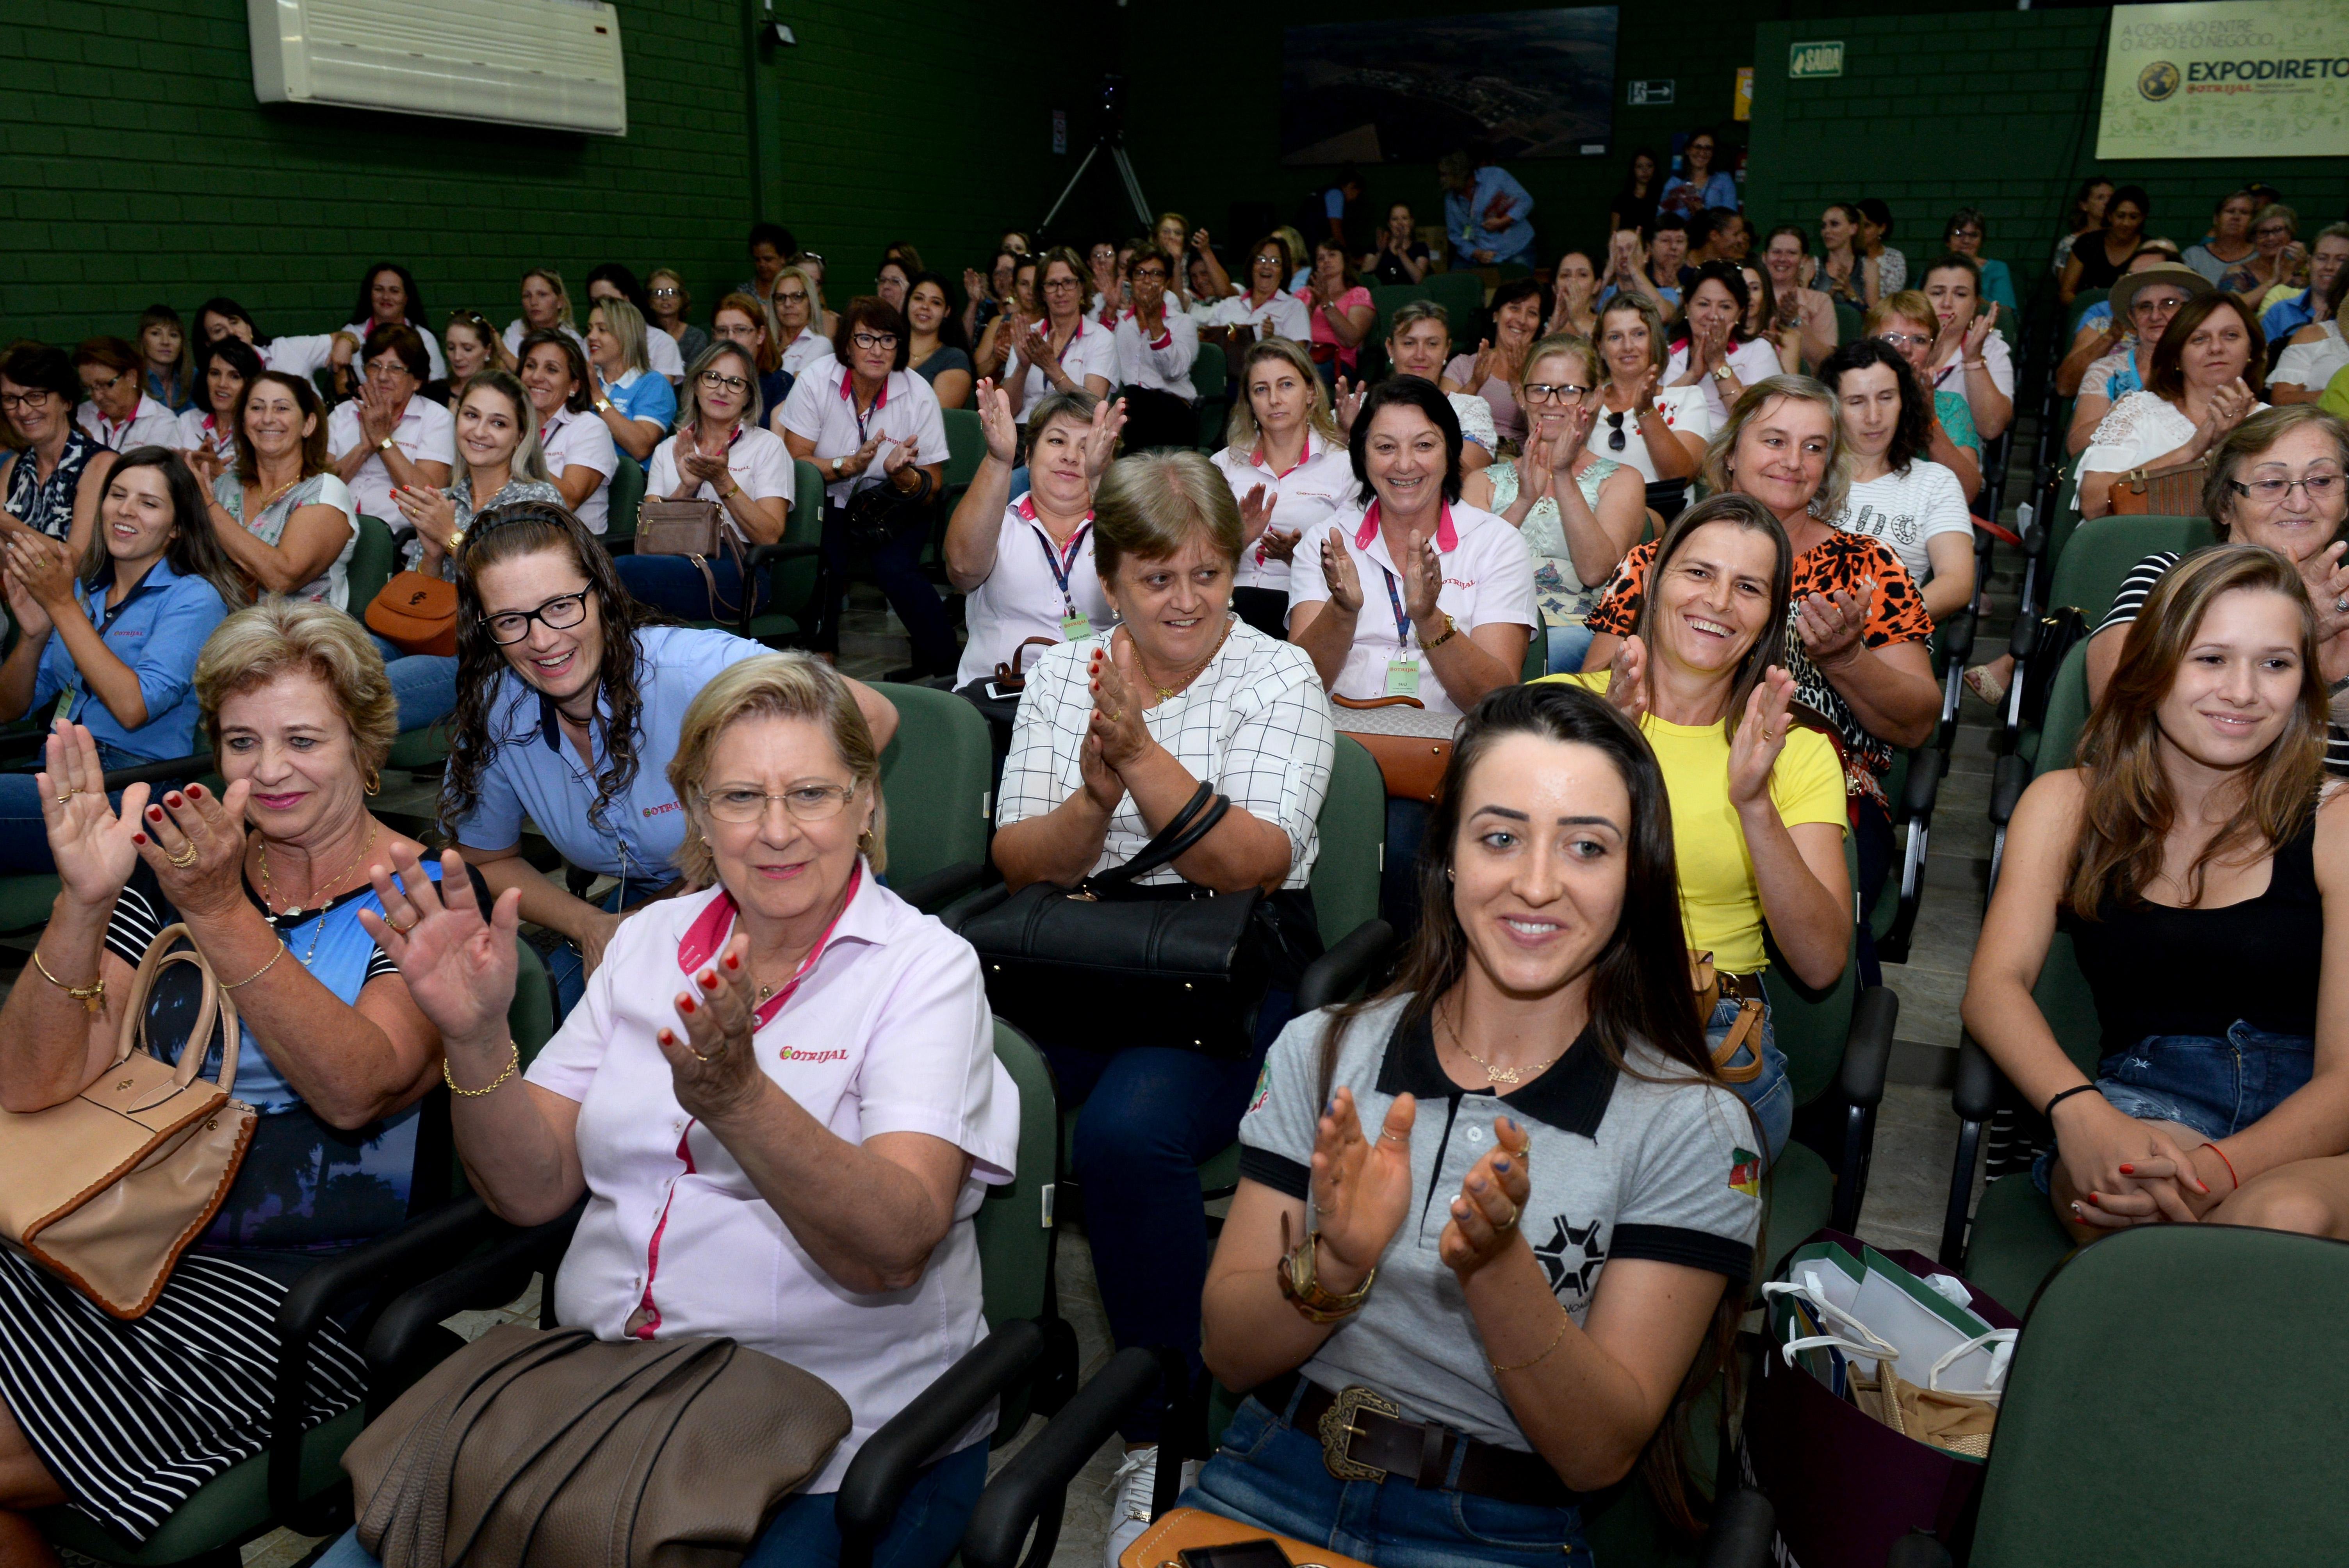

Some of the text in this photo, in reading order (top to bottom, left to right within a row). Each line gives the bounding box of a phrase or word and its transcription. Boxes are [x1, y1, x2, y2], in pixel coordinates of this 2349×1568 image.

[2187, 57, 2349, 81] EXPODIRETO
[1442, 578, 1476, 590] OTRIJAL
[779, 1046, 849, 1064] COTRIJAL
